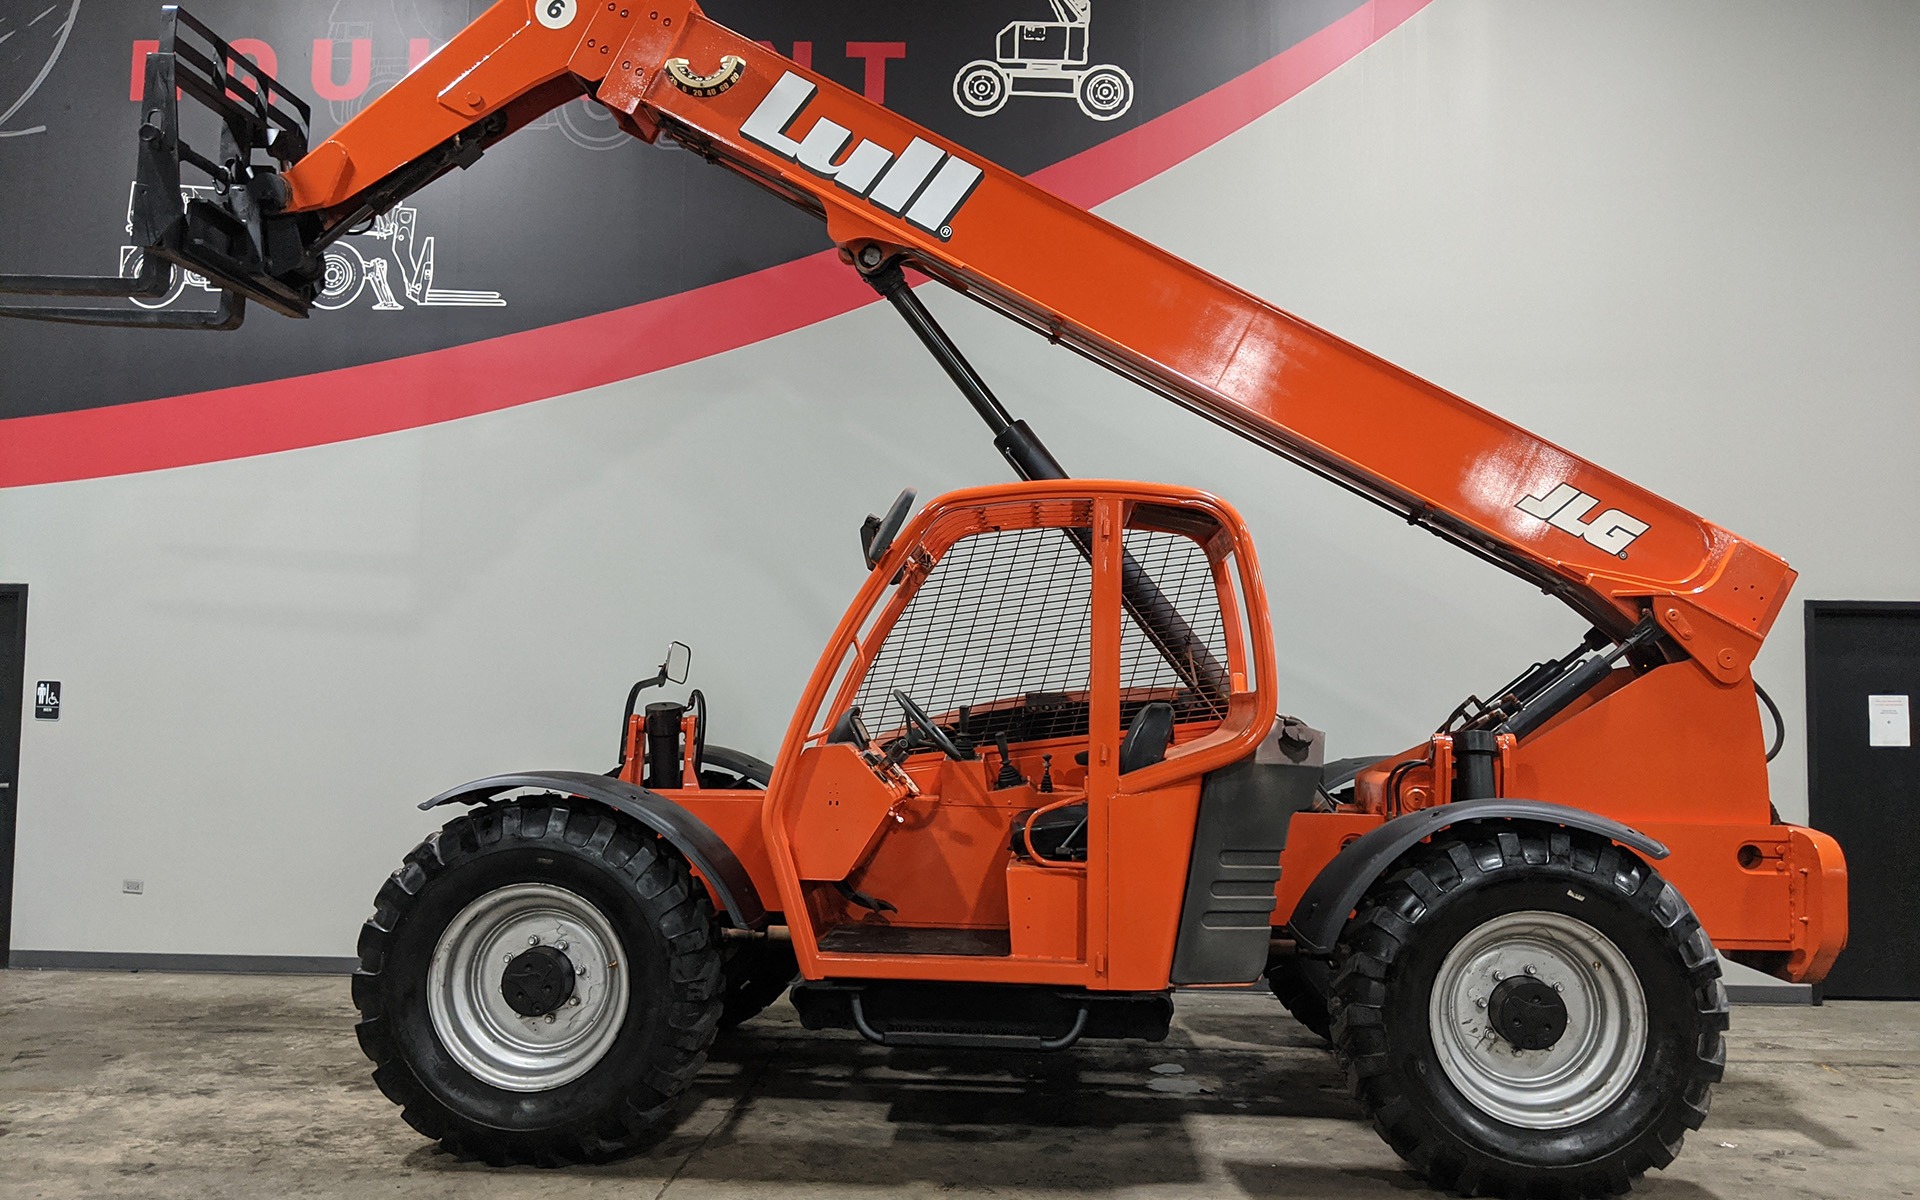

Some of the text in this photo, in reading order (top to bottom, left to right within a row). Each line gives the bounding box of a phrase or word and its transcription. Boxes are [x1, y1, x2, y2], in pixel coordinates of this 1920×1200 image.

[547, 0, 566, 19] 6
[693, 89, 703, 97] 20
[707, 88, 717, 96] 40
[720, 82, 729, 92] 60
[730, 72, 740, 83] 80
[739, 70, 985, 237] Lull
[1514, 482, 1652, 557] JLG
